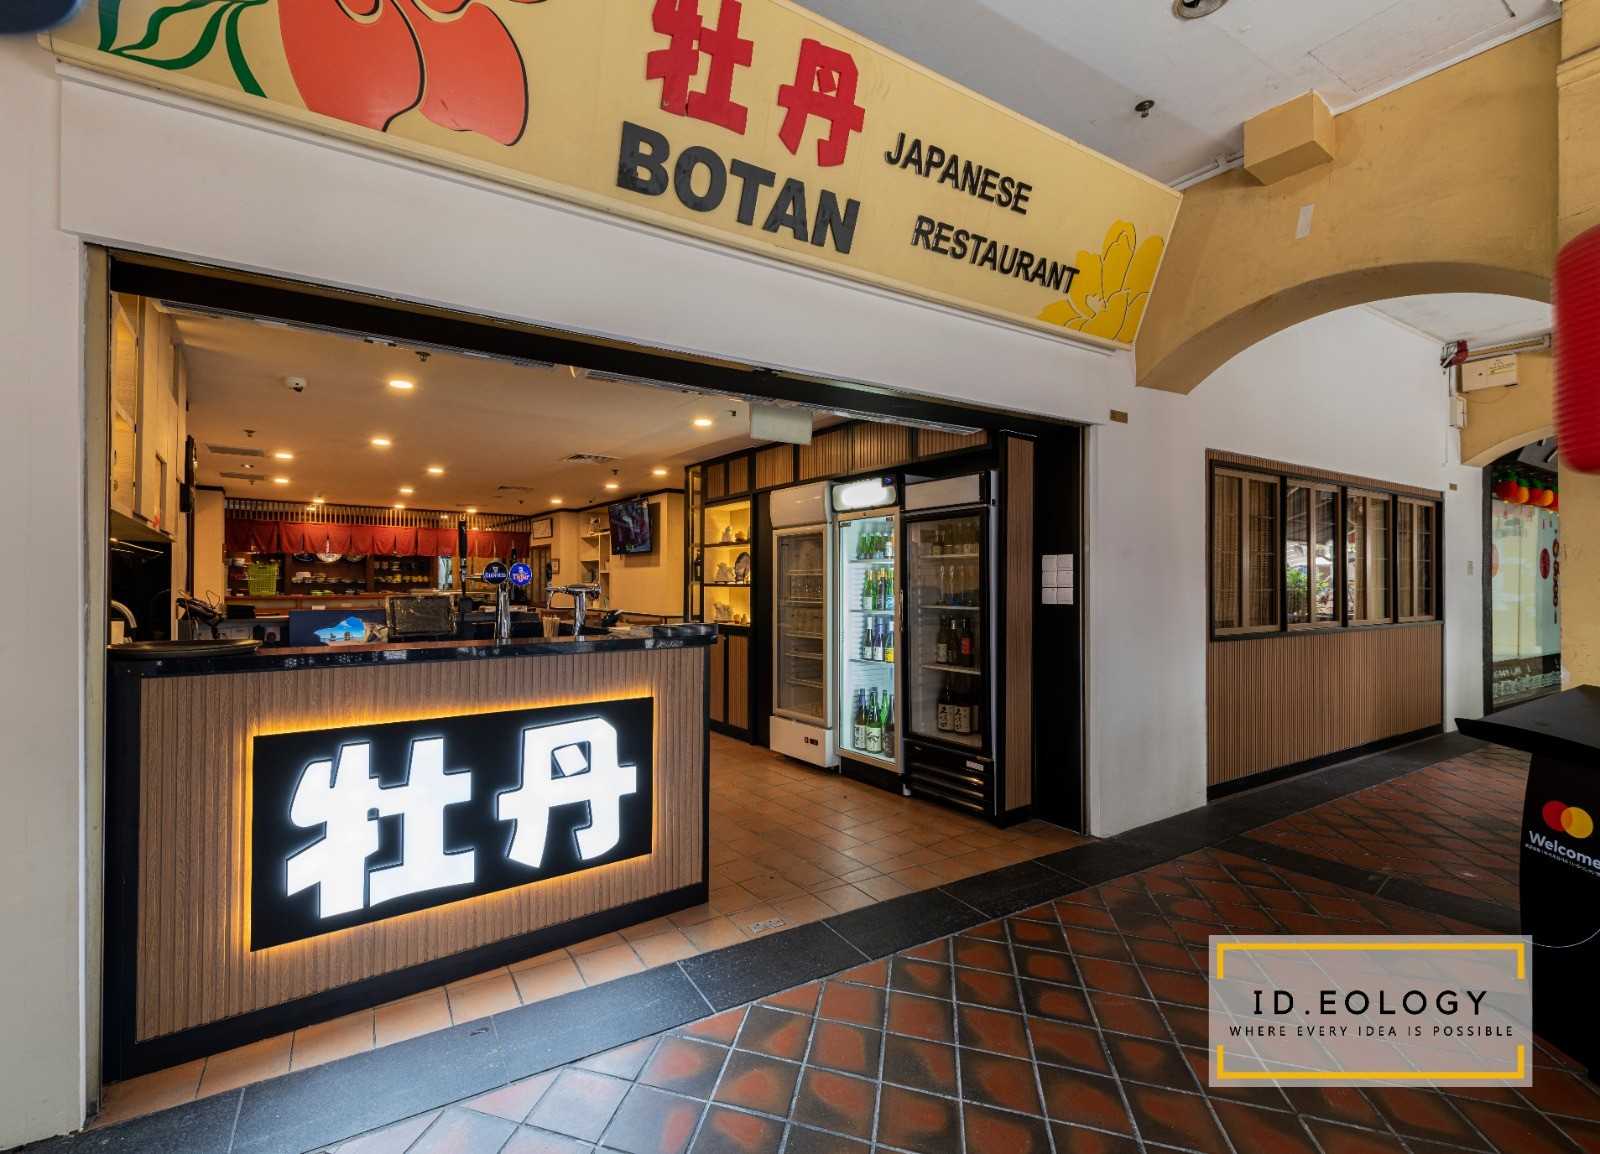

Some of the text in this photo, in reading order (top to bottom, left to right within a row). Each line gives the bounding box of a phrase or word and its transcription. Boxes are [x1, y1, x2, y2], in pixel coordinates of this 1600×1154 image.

[646, 0, 865, 167] 牡丹
[616, 120, 861, 255] BOTAN
[884, 132, 1033, 215] JAPANESE
[911, 215, 1080, 295] RESTAURANT
[286, 717, 638, 919] 牡丹
[1529, 830, 1600, 870] Welcome
